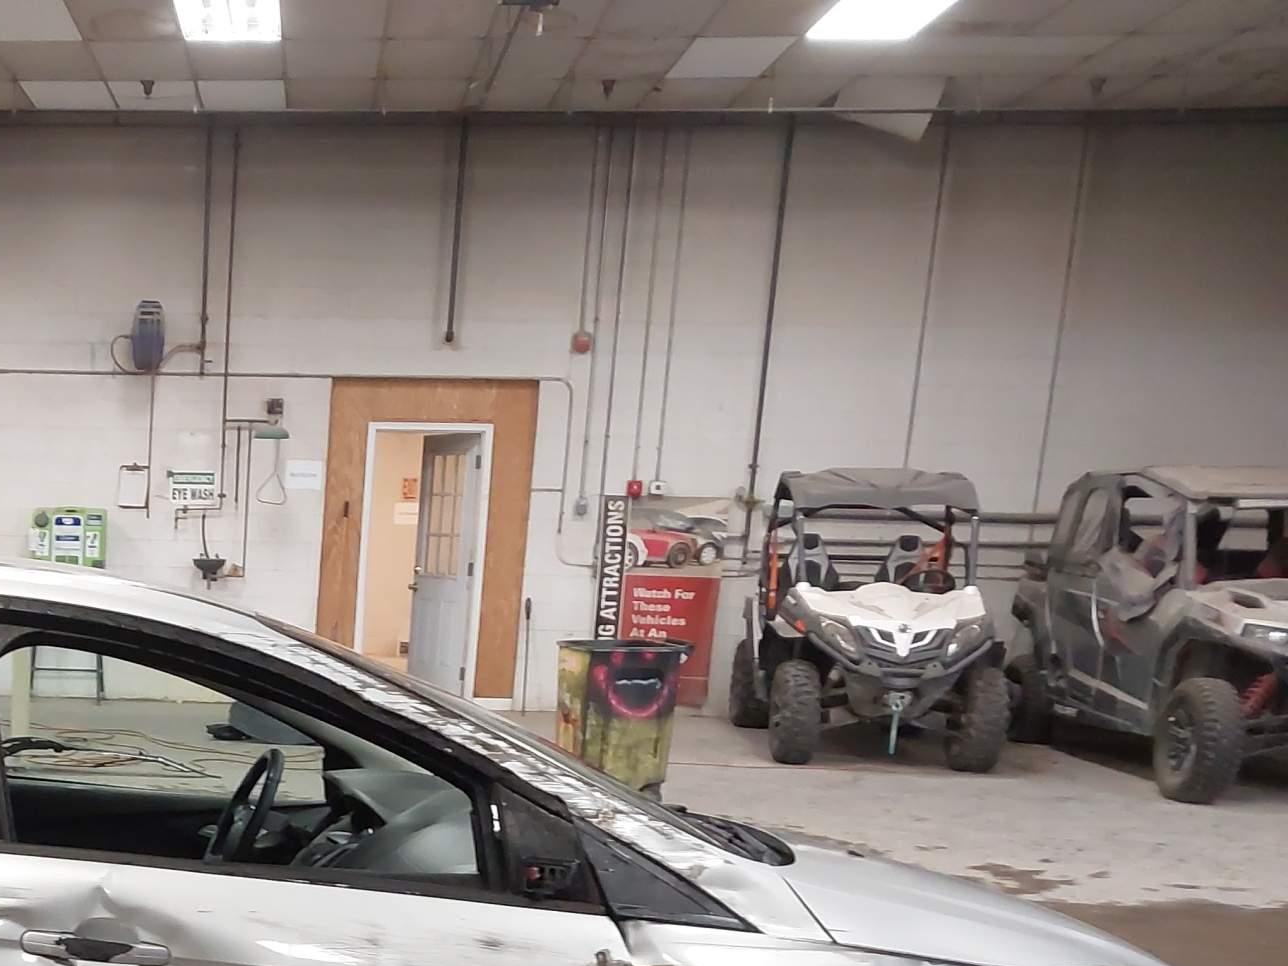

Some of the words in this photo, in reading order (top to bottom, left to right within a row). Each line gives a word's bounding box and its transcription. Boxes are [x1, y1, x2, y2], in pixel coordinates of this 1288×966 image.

[172, 487, 188, 500] EYE
[190, 487, 215, 500] WASH
[600, 500, 626, 620] ATTRACTIONS
[633, 587, 671, 599] Watch
[674, 588, 696, 600] For
[632, 600, 671, 612] These
[631, 614, 687, 626] Vehicles
[629, 627, 645, 638] At
[648, 627, 667, 638] An
